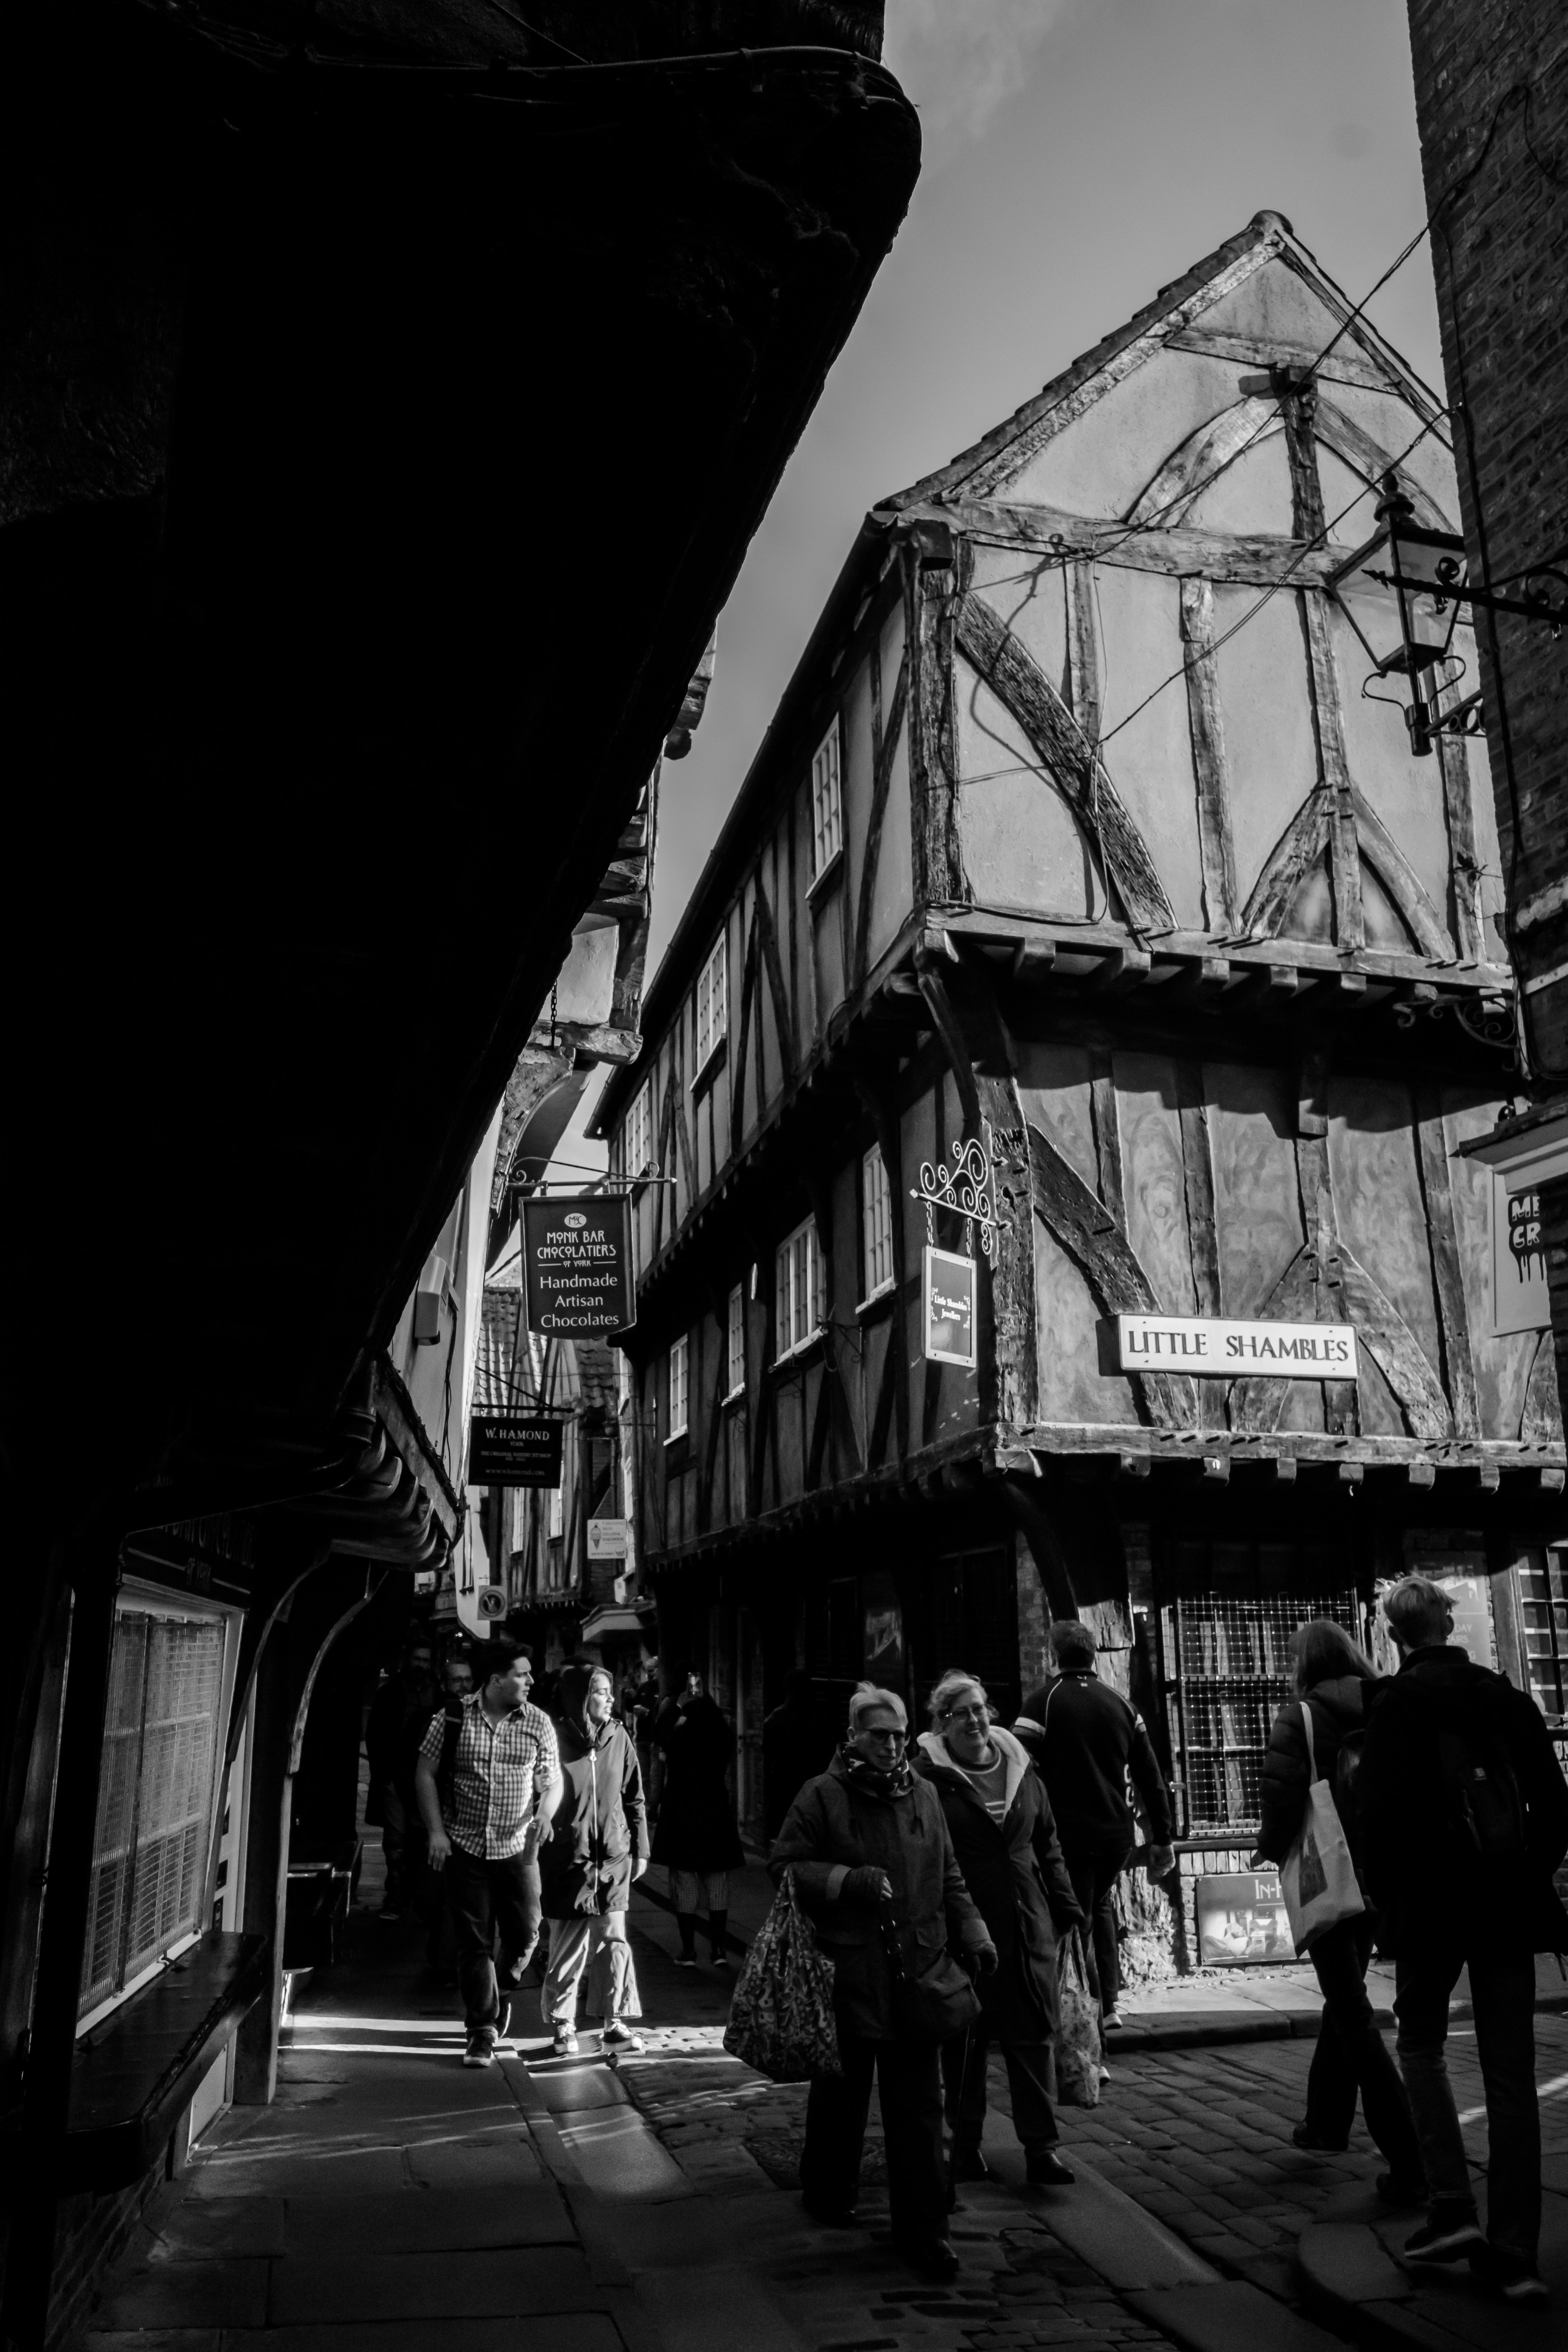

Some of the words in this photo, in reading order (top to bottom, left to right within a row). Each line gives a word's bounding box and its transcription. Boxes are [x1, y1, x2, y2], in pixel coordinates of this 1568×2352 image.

[547, 1231, 578, 1244] MONK
[583, 1230, 605, 1243] BAR
[537, 1244, 616, 1259] CHOCOLATIERS
[540, 1273, 618, 1289] Handmade
[555, 1294, 603, 1307] Artisan
[934, 1295, 946, 1305] Little
[947, 1298, 967, 1311] Shambles
[541, 1312, 619, 1328] Chocolates
[941, 1308, 960, 1321] Jewellers
[1128, 1330, 1208, 1356] LITTLE
[1226, 1335, 1349, 1361] SHAMBLES
[485, 1427, 497, 1439] W.
[499, 1429, 550, 1441] HAMOND
[1450, 1635, 1469, 1644] AIRS
